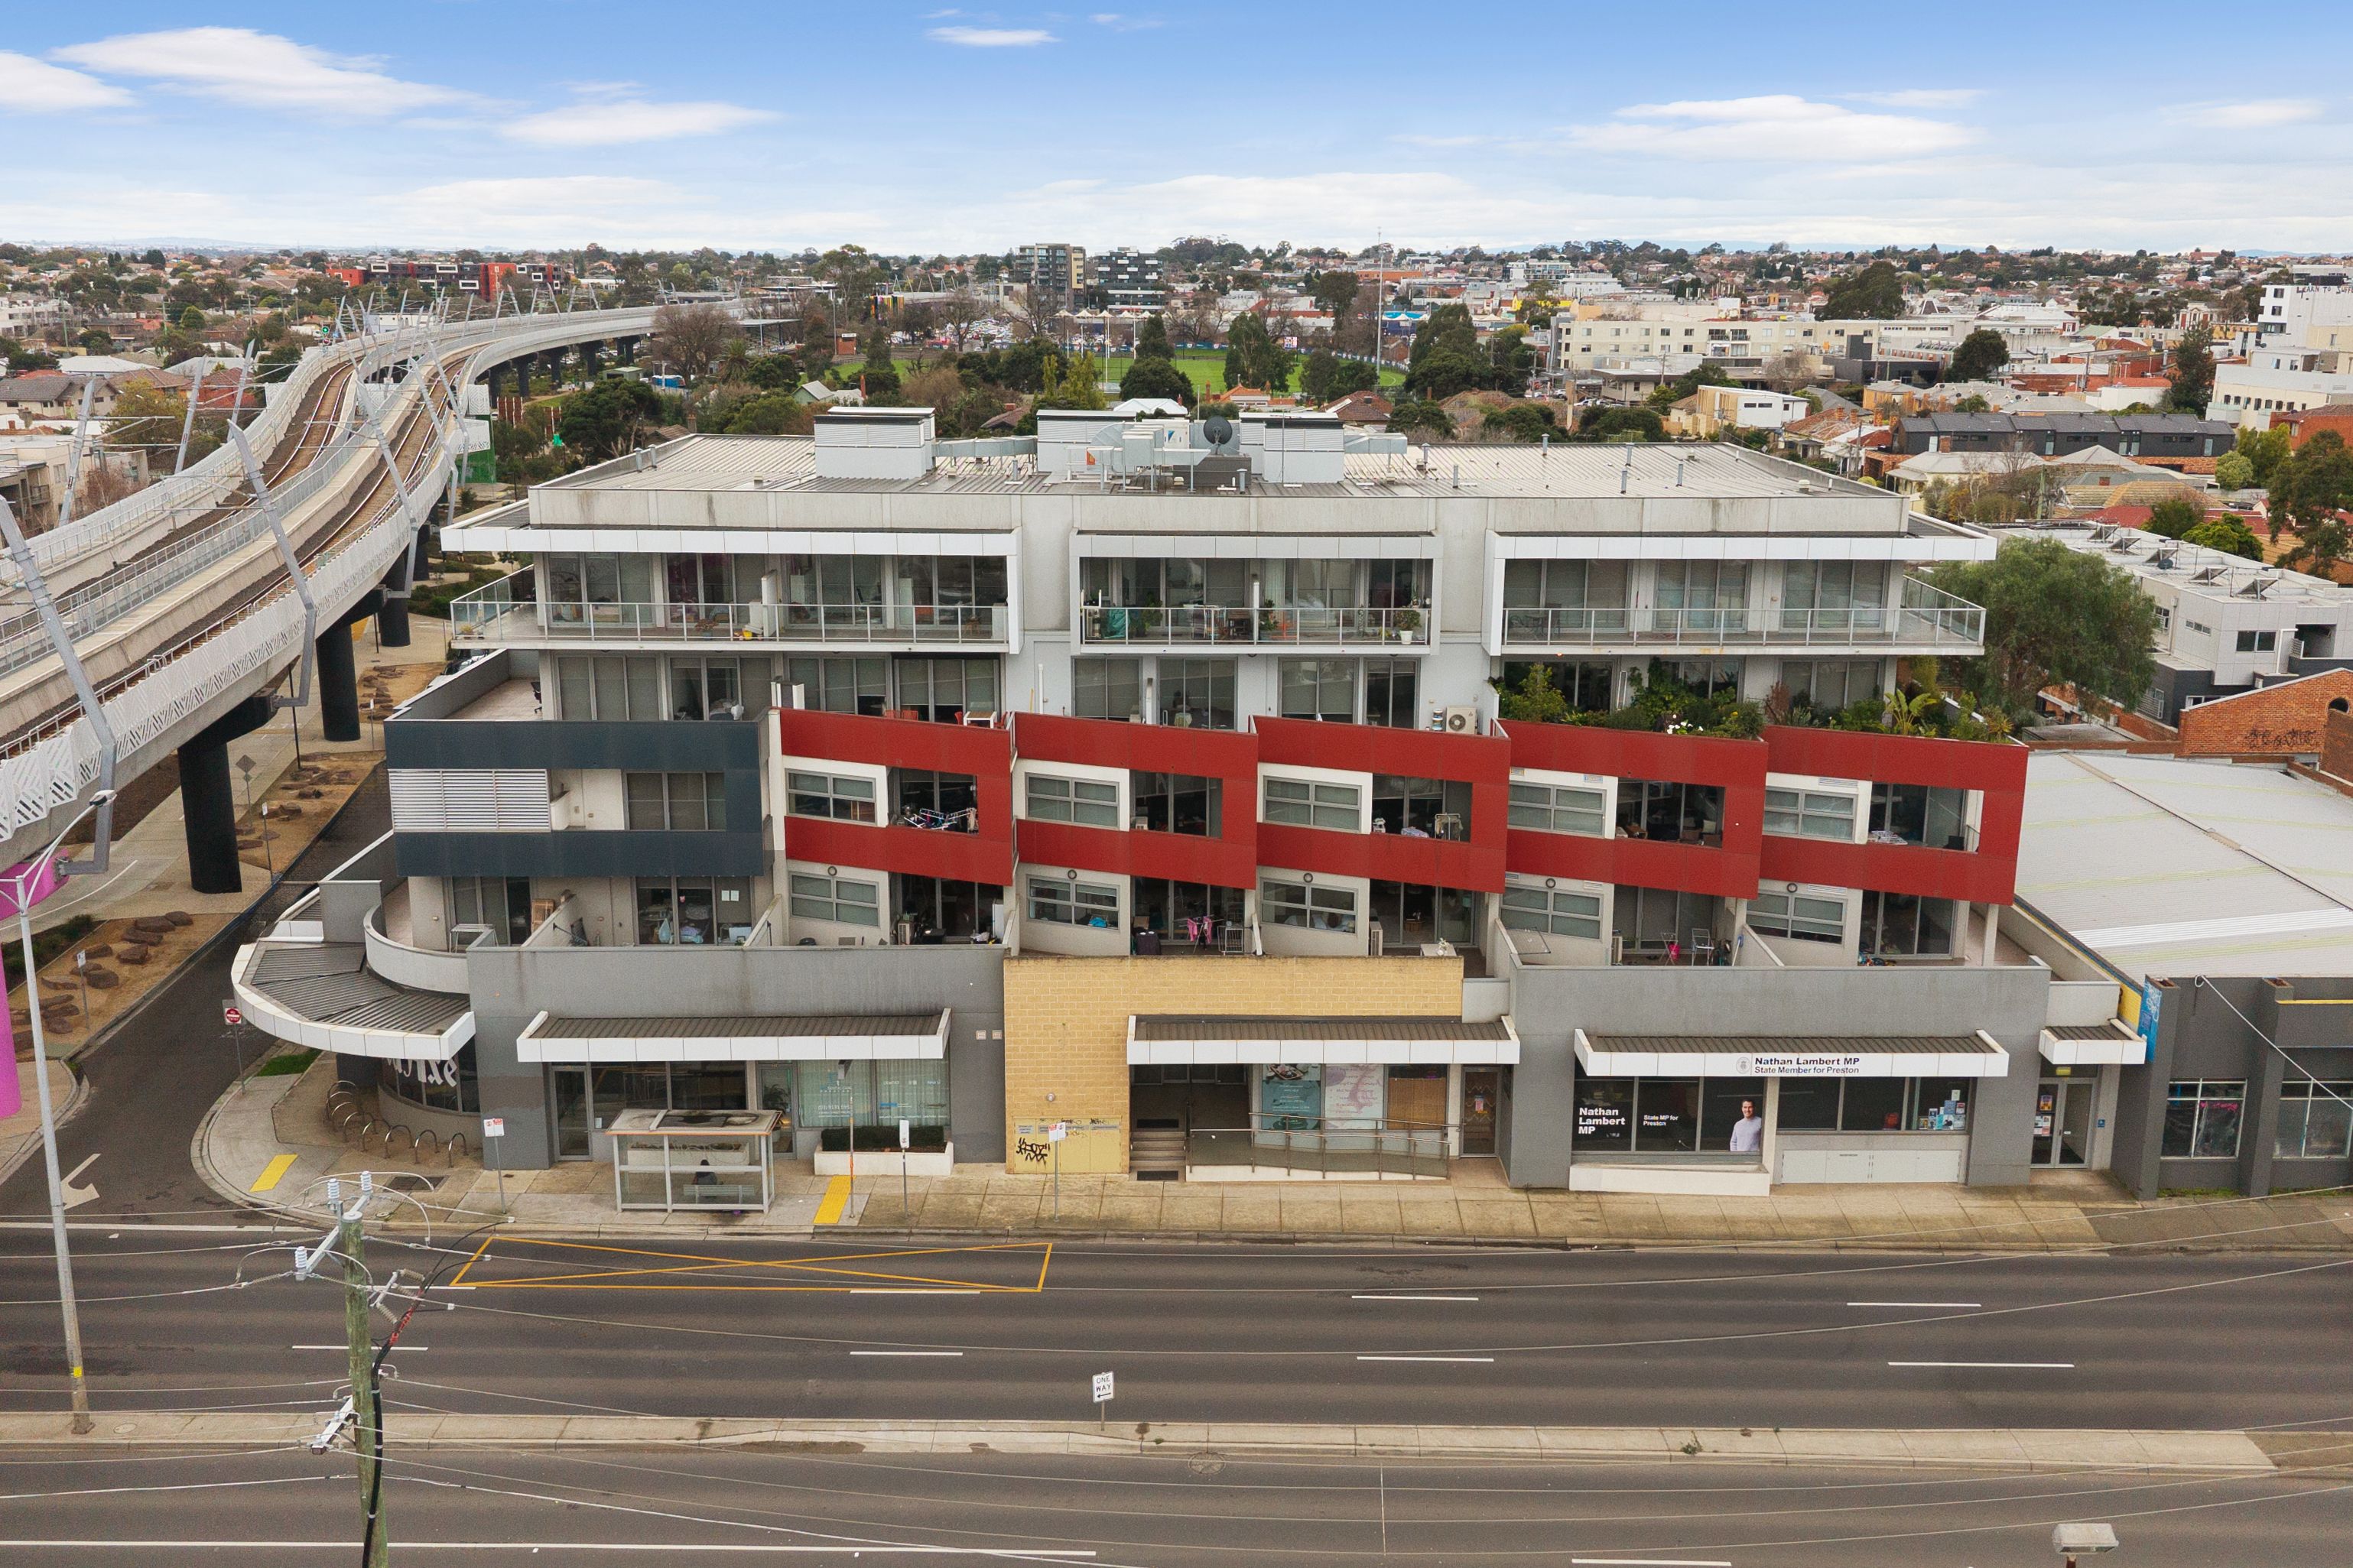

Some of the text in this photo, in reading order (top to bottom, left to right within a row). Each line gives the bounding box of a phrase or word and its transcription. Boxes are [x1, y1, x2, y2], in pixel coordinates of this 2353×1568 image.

[2296, 287, 2319, 296] LEARN
[1579, 1107, 1619, 1115] Nathan
[1578, 1117, 1626, 1125] Lambert
[1578, 1126, 1595, 1135] MP
[1097, 1375, 1110, 1383] ONE
[1096, 1383, 1111, 1392] WAY
